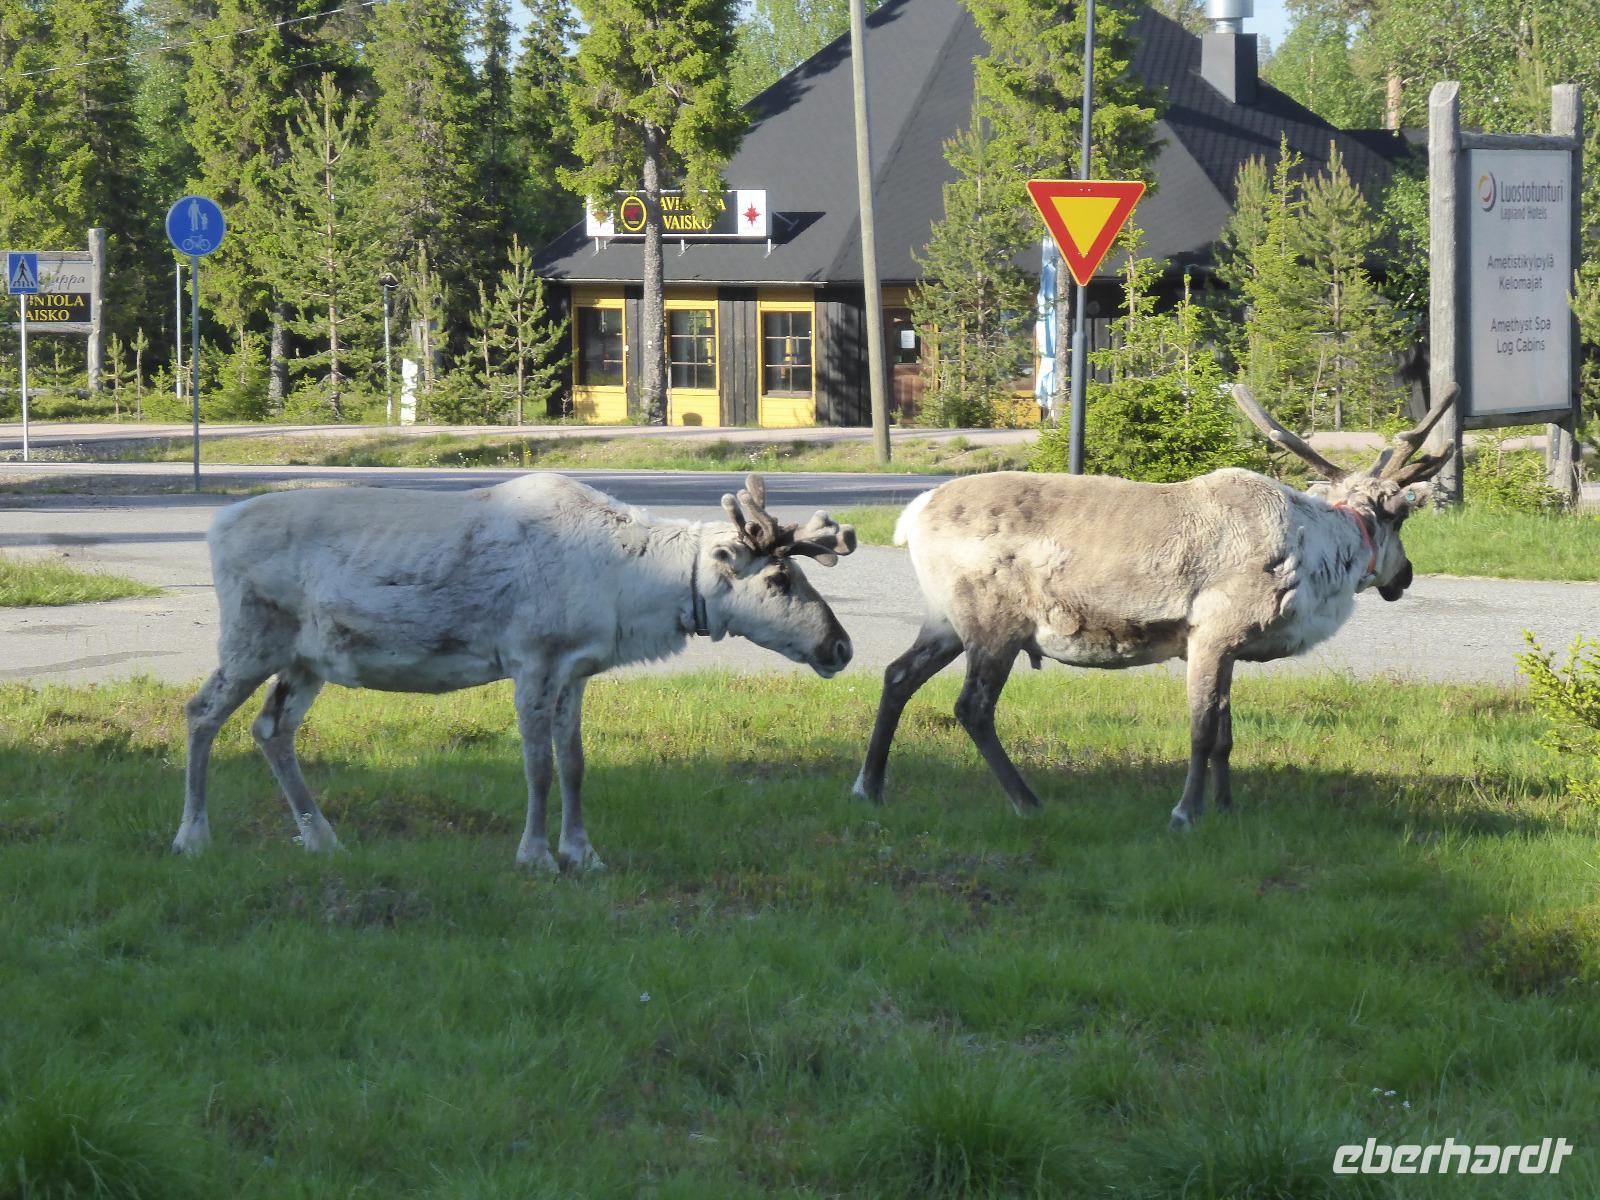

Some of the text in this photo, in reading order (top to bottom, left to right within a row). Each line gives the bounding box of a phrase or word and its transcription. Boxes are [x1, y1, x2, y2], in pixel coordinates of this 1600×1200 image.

[1500, 179, 1564, 203] Luostotunturi
[1500, 204, 1548, 222] Lapland Hotels
[1486, 253, 1554, 271] Ametistikylpylä
[1498, 275, 1543, 292] Kelomajat
[1490, 315, 1551, 334] Amethyst Spa
[1496, 336, 1546, 355] Log Cabins
